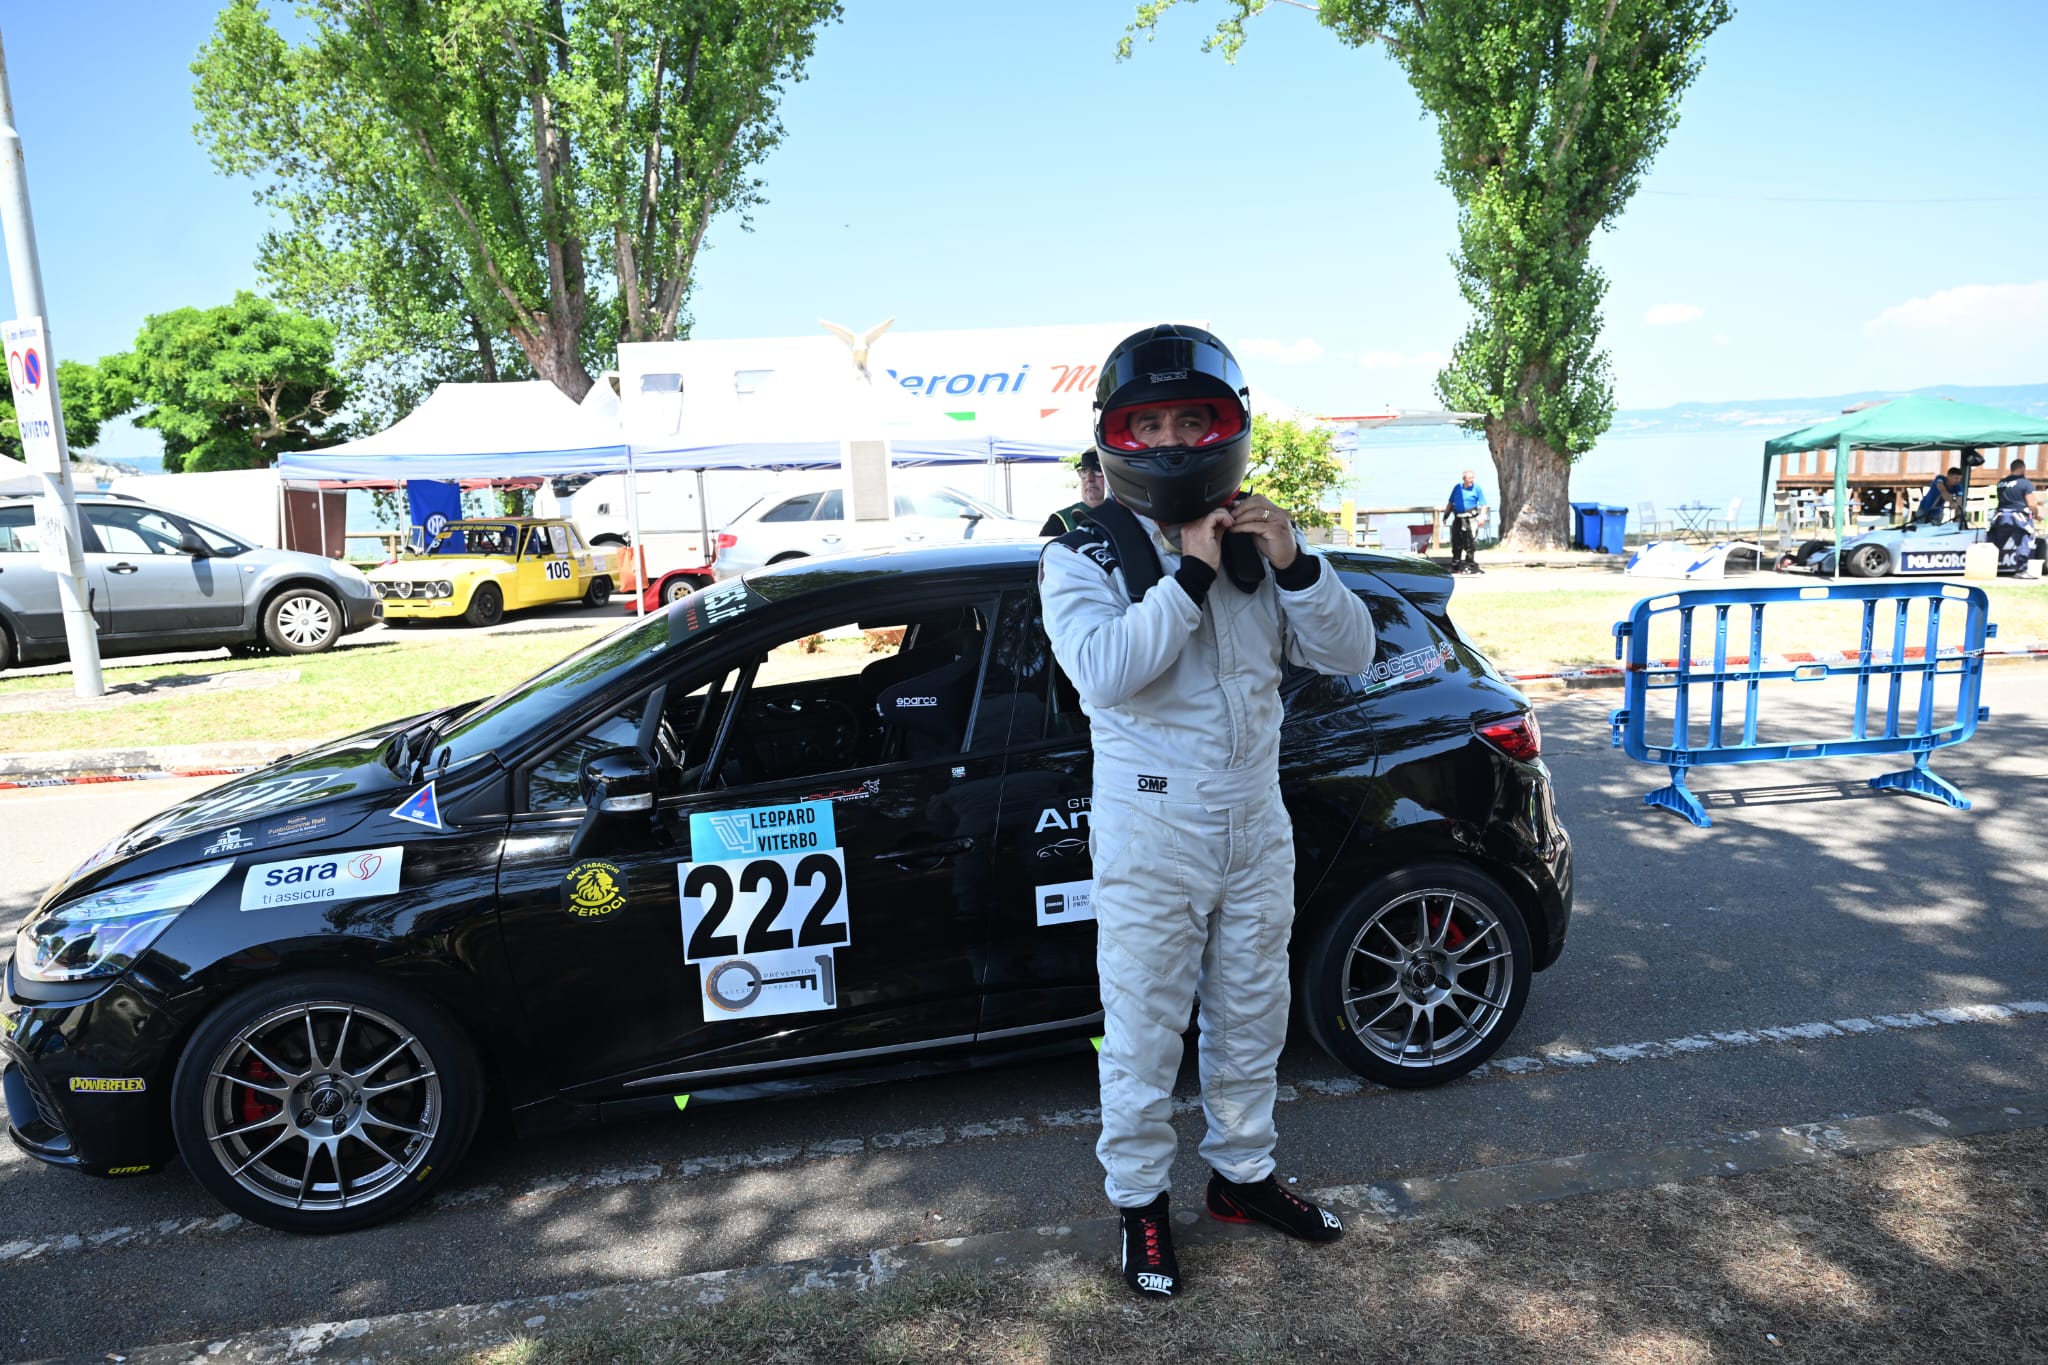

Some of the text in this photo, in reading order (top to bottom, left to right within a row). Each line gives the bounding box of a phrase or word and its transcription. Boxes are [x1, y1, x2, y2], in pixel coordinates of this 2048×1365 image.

[886, 365, 1032, 397] eroni
[21, 420, 50, 440] DIVIETO
[546, 561, 571, 580] 106
[896, 696, 938, 708] sparco
[1137, 777, 1168, 791] OMP
[750, 807, 816, 829] LEOPARD
[757, 831, 818, 852] VITERBO
[264, 862, 338, 887] sara
[566, 862, 621, 881] BAR TABACCHI
[262, 887, 336, 905] ti assicura
[568, 896, 627, 917] FEROCI
[683, 853, 848, 960] 222
[71, 1077, 144, 1091] POWERFLEX
[1137, 1274, 1174, 1293] OMP
